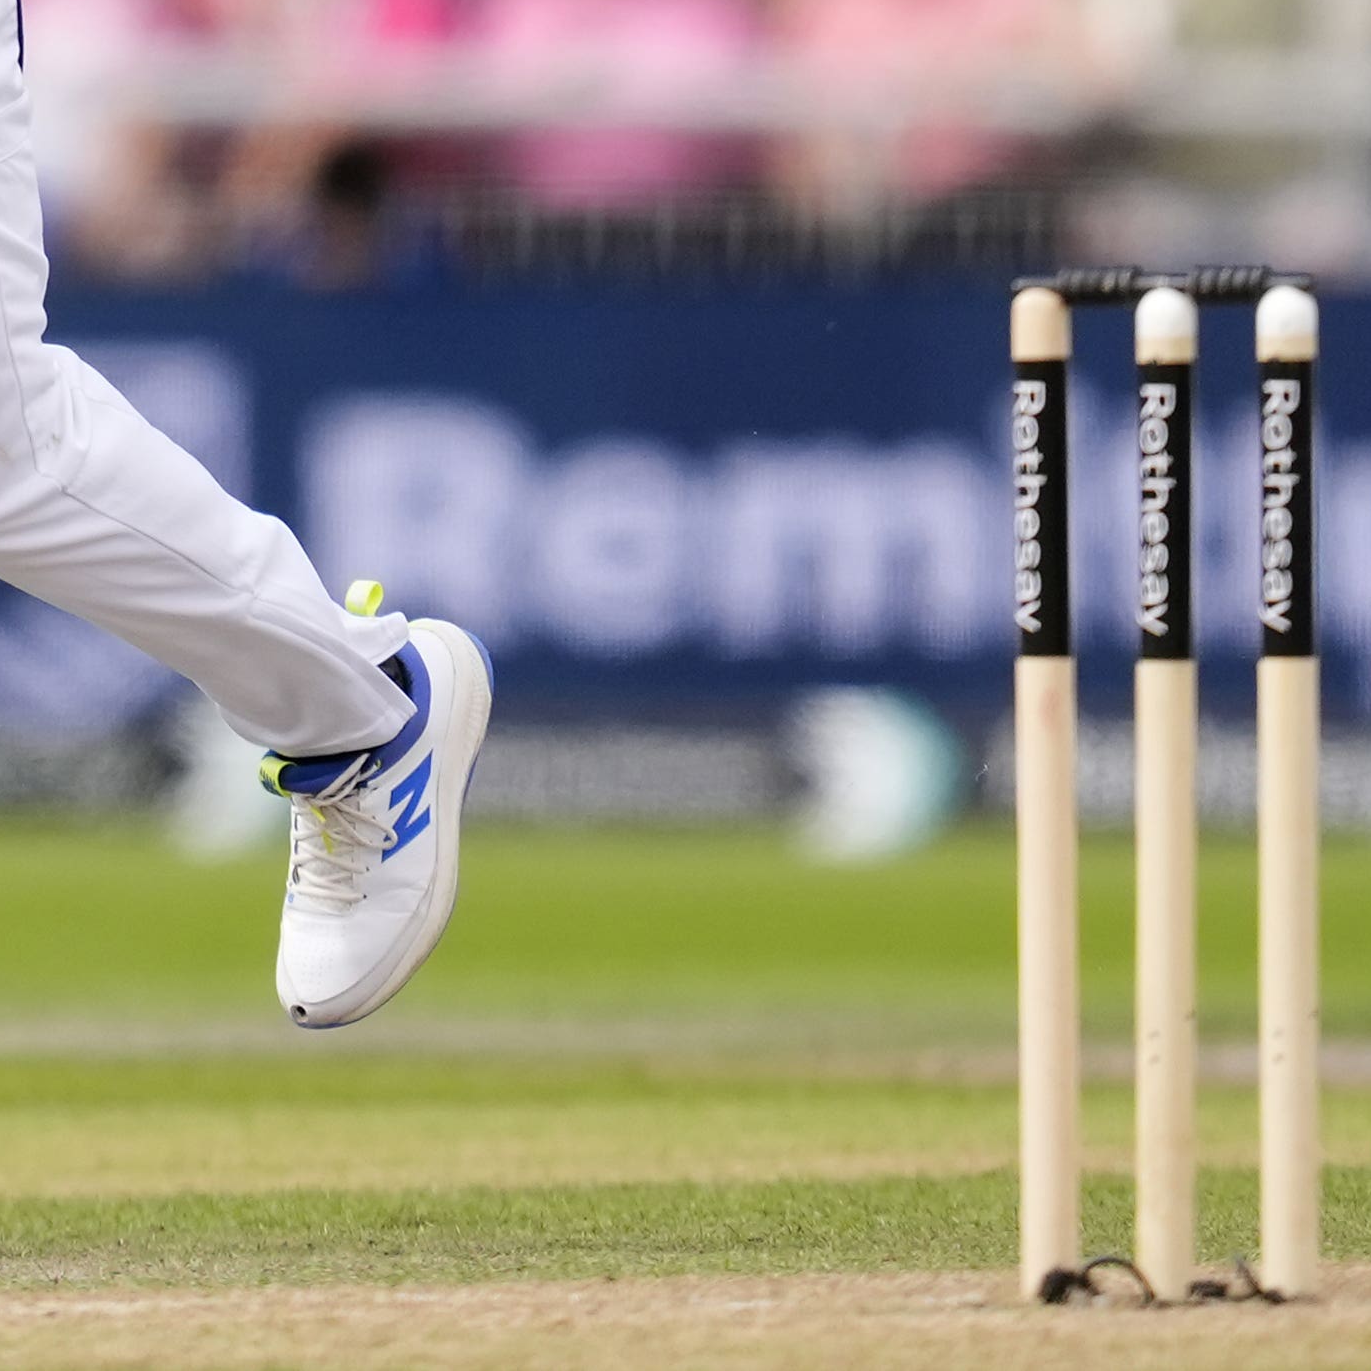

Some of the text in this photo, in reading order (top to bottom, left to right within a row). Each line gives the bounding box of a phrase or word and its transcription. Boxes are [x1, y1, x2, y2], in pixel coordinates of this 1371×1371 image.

[1013, 380, 1047, 634] Rothesay
[1136, 382, 1178, 636] Rothesay
[1257, 378, 1301, 634] Rothesay
